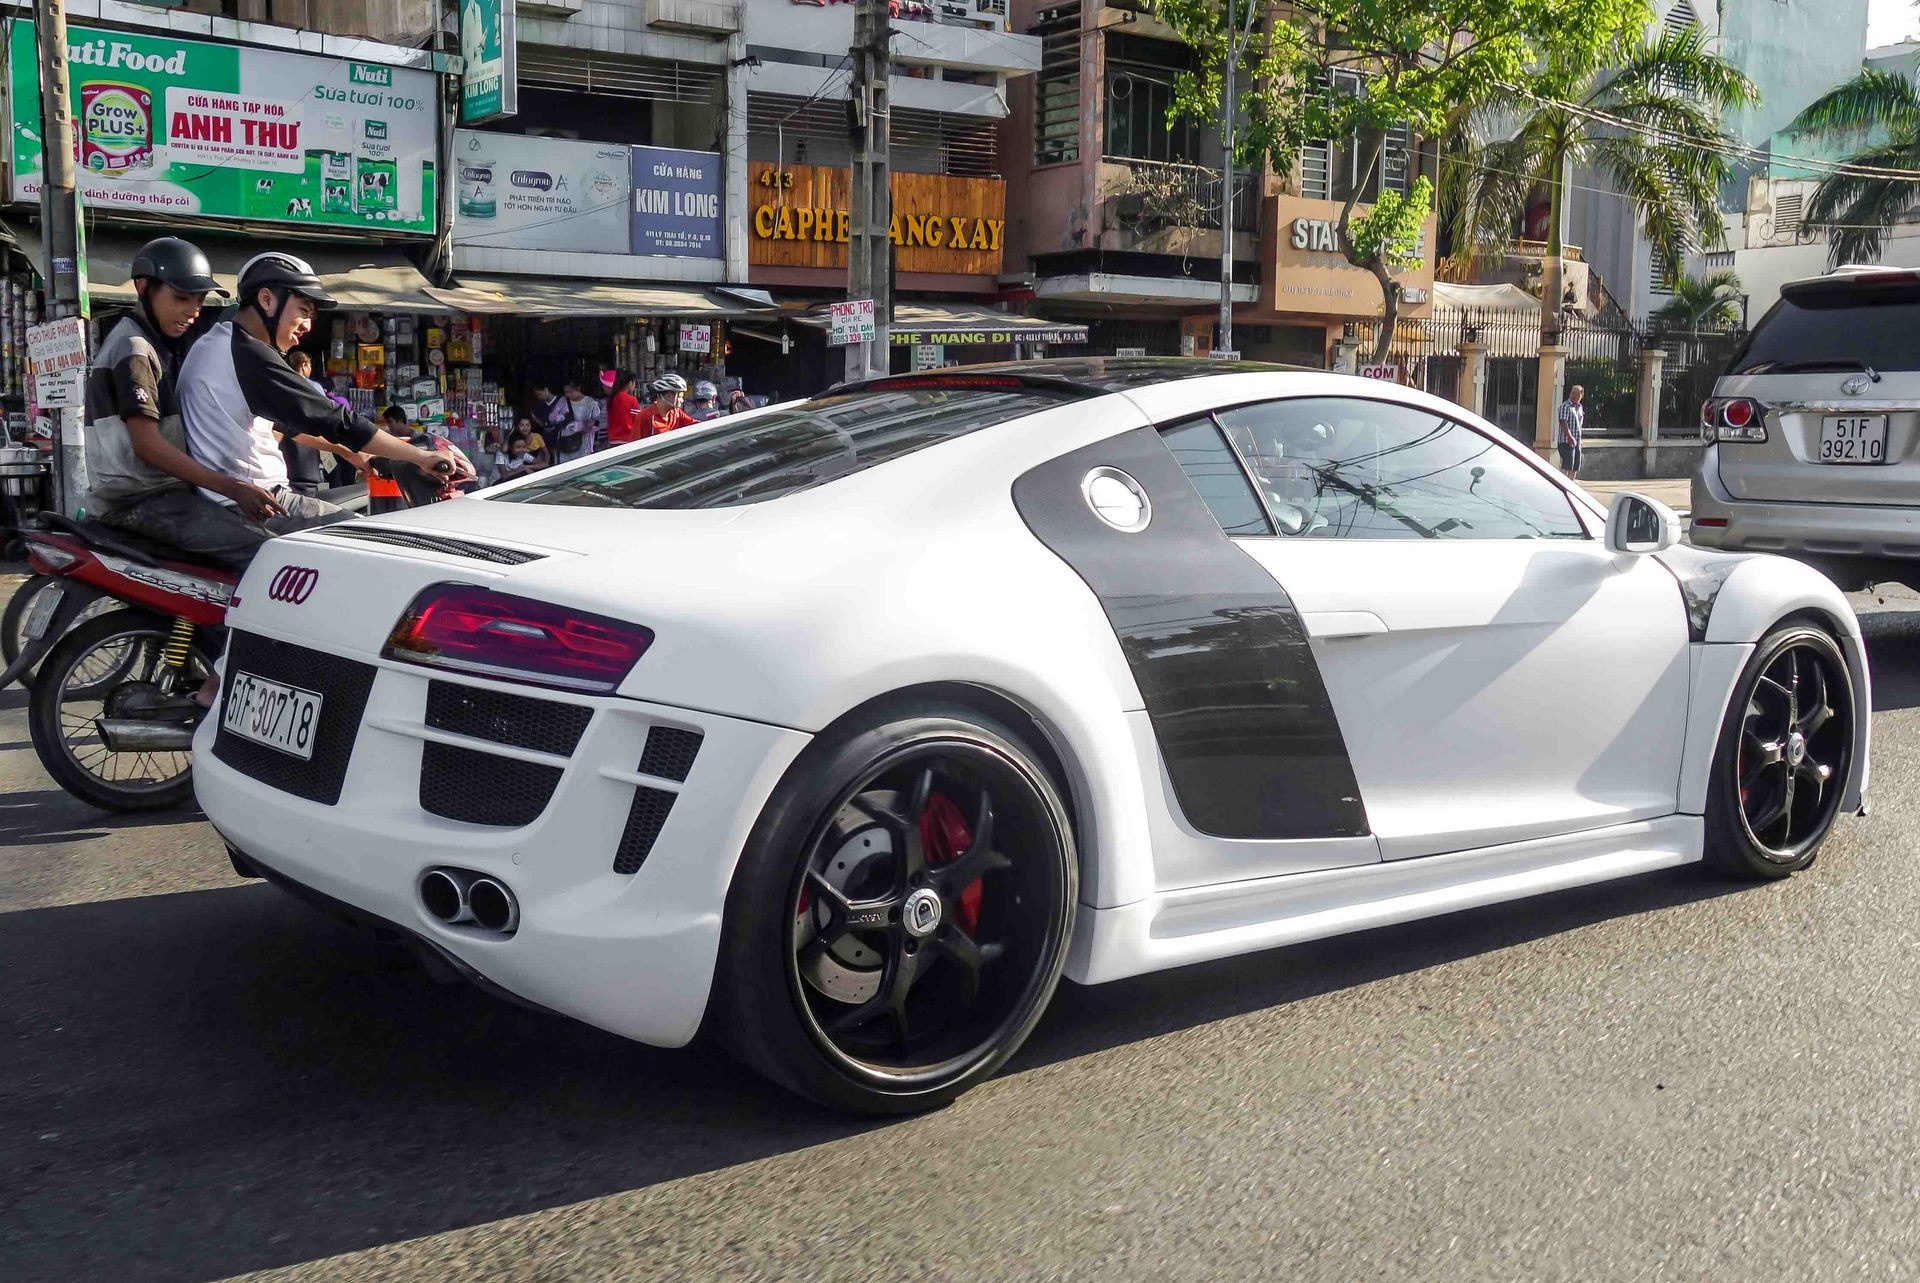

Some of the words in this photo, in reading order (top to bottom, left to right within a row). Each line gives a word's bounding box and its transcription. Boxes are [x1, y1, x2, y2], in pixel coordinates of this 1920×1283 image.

[66, 39, 187, 75] utiFood
[353, 64, 389, 84] Nuti
[464, 82, 479, 99] KIM
[480, 75, 499, 96] LONG
[92, 102, 138, 120] Grow
[386, 95, 425, 112] 100%
[171, 111, 232, 143] ANH
[240, 119, 301, 150] THƯ
[653, 162, 674, 177] CỬA
[676, 166, 703, 180] HÀNG
[760, 170, 794, 188] 413
[636, 188, 669, 215] KIM
[674, 191, 719, 218] LONG
[887, 212, 943, 247] ANG
[949, 217, 1005, 251] XAY
[930, 333, 986, 344] MANG
[1836, 418, 1870, 439] 51F
[1822, 439, 1881, 460] 392.10
[226, 675, 314, 750] 51F-307.18
